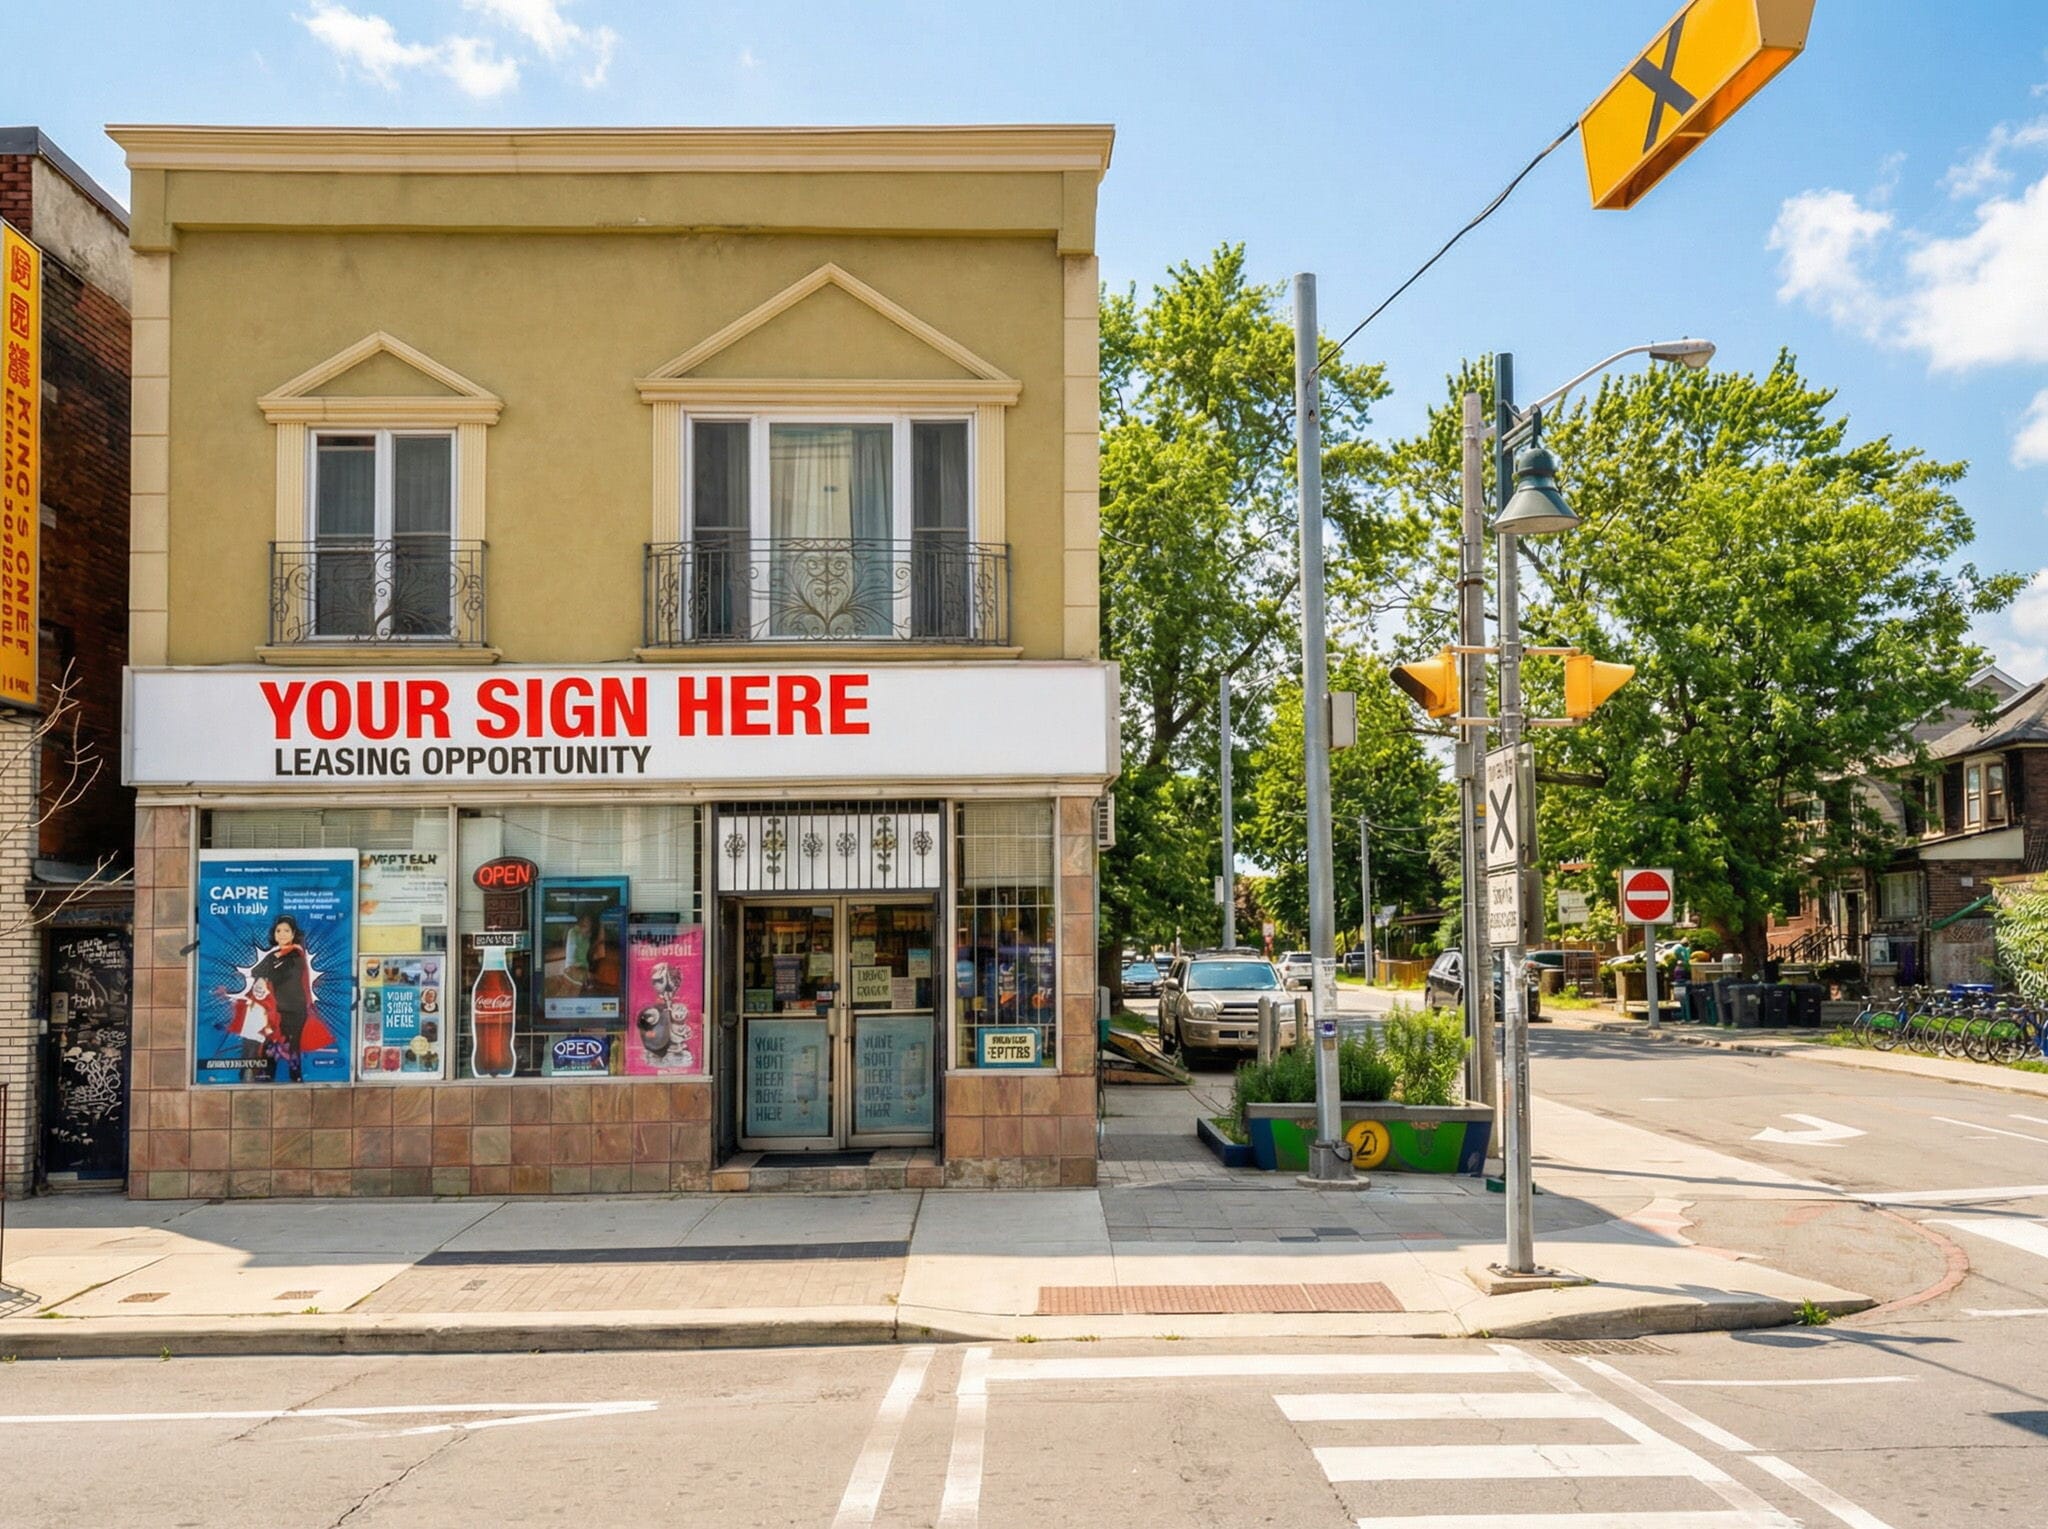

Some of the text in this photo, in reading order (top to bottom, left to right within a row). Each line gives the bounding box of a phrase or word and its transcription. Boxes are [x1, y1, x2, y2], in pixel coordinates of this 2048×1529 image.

[260, 674, 870, 740] YOUR SIGN HERE
[275, 744, 652, 776] LEASING OPPORTUNITY
[479, 864, 531, 886] OPEN
[210, 886, 269, 900] CAPRE
[554, 1041, 602, 1056] OPEN
